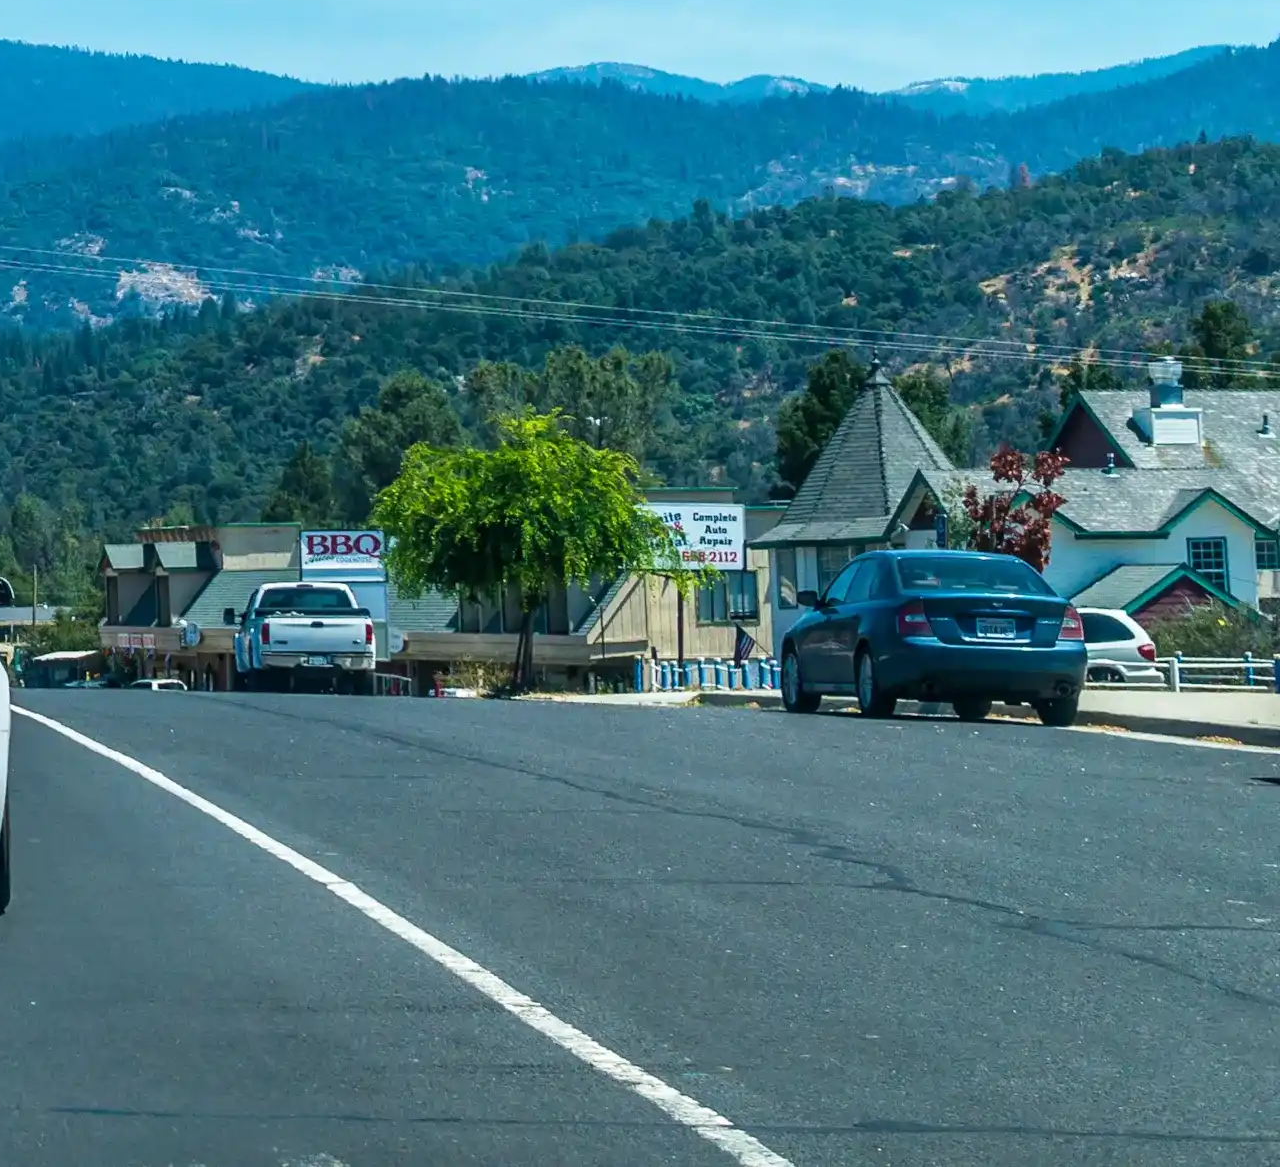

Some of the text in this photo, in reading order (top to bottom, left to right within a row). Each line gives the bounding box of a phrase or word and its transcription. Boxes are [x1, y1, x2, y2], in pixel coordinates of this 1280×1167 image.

[692, 512, 738, 524] Complete
[704, 525, 728, 534] Auto
[306, 534, 382, 559] BBQ
[699, 536, 733, 546] Repair
